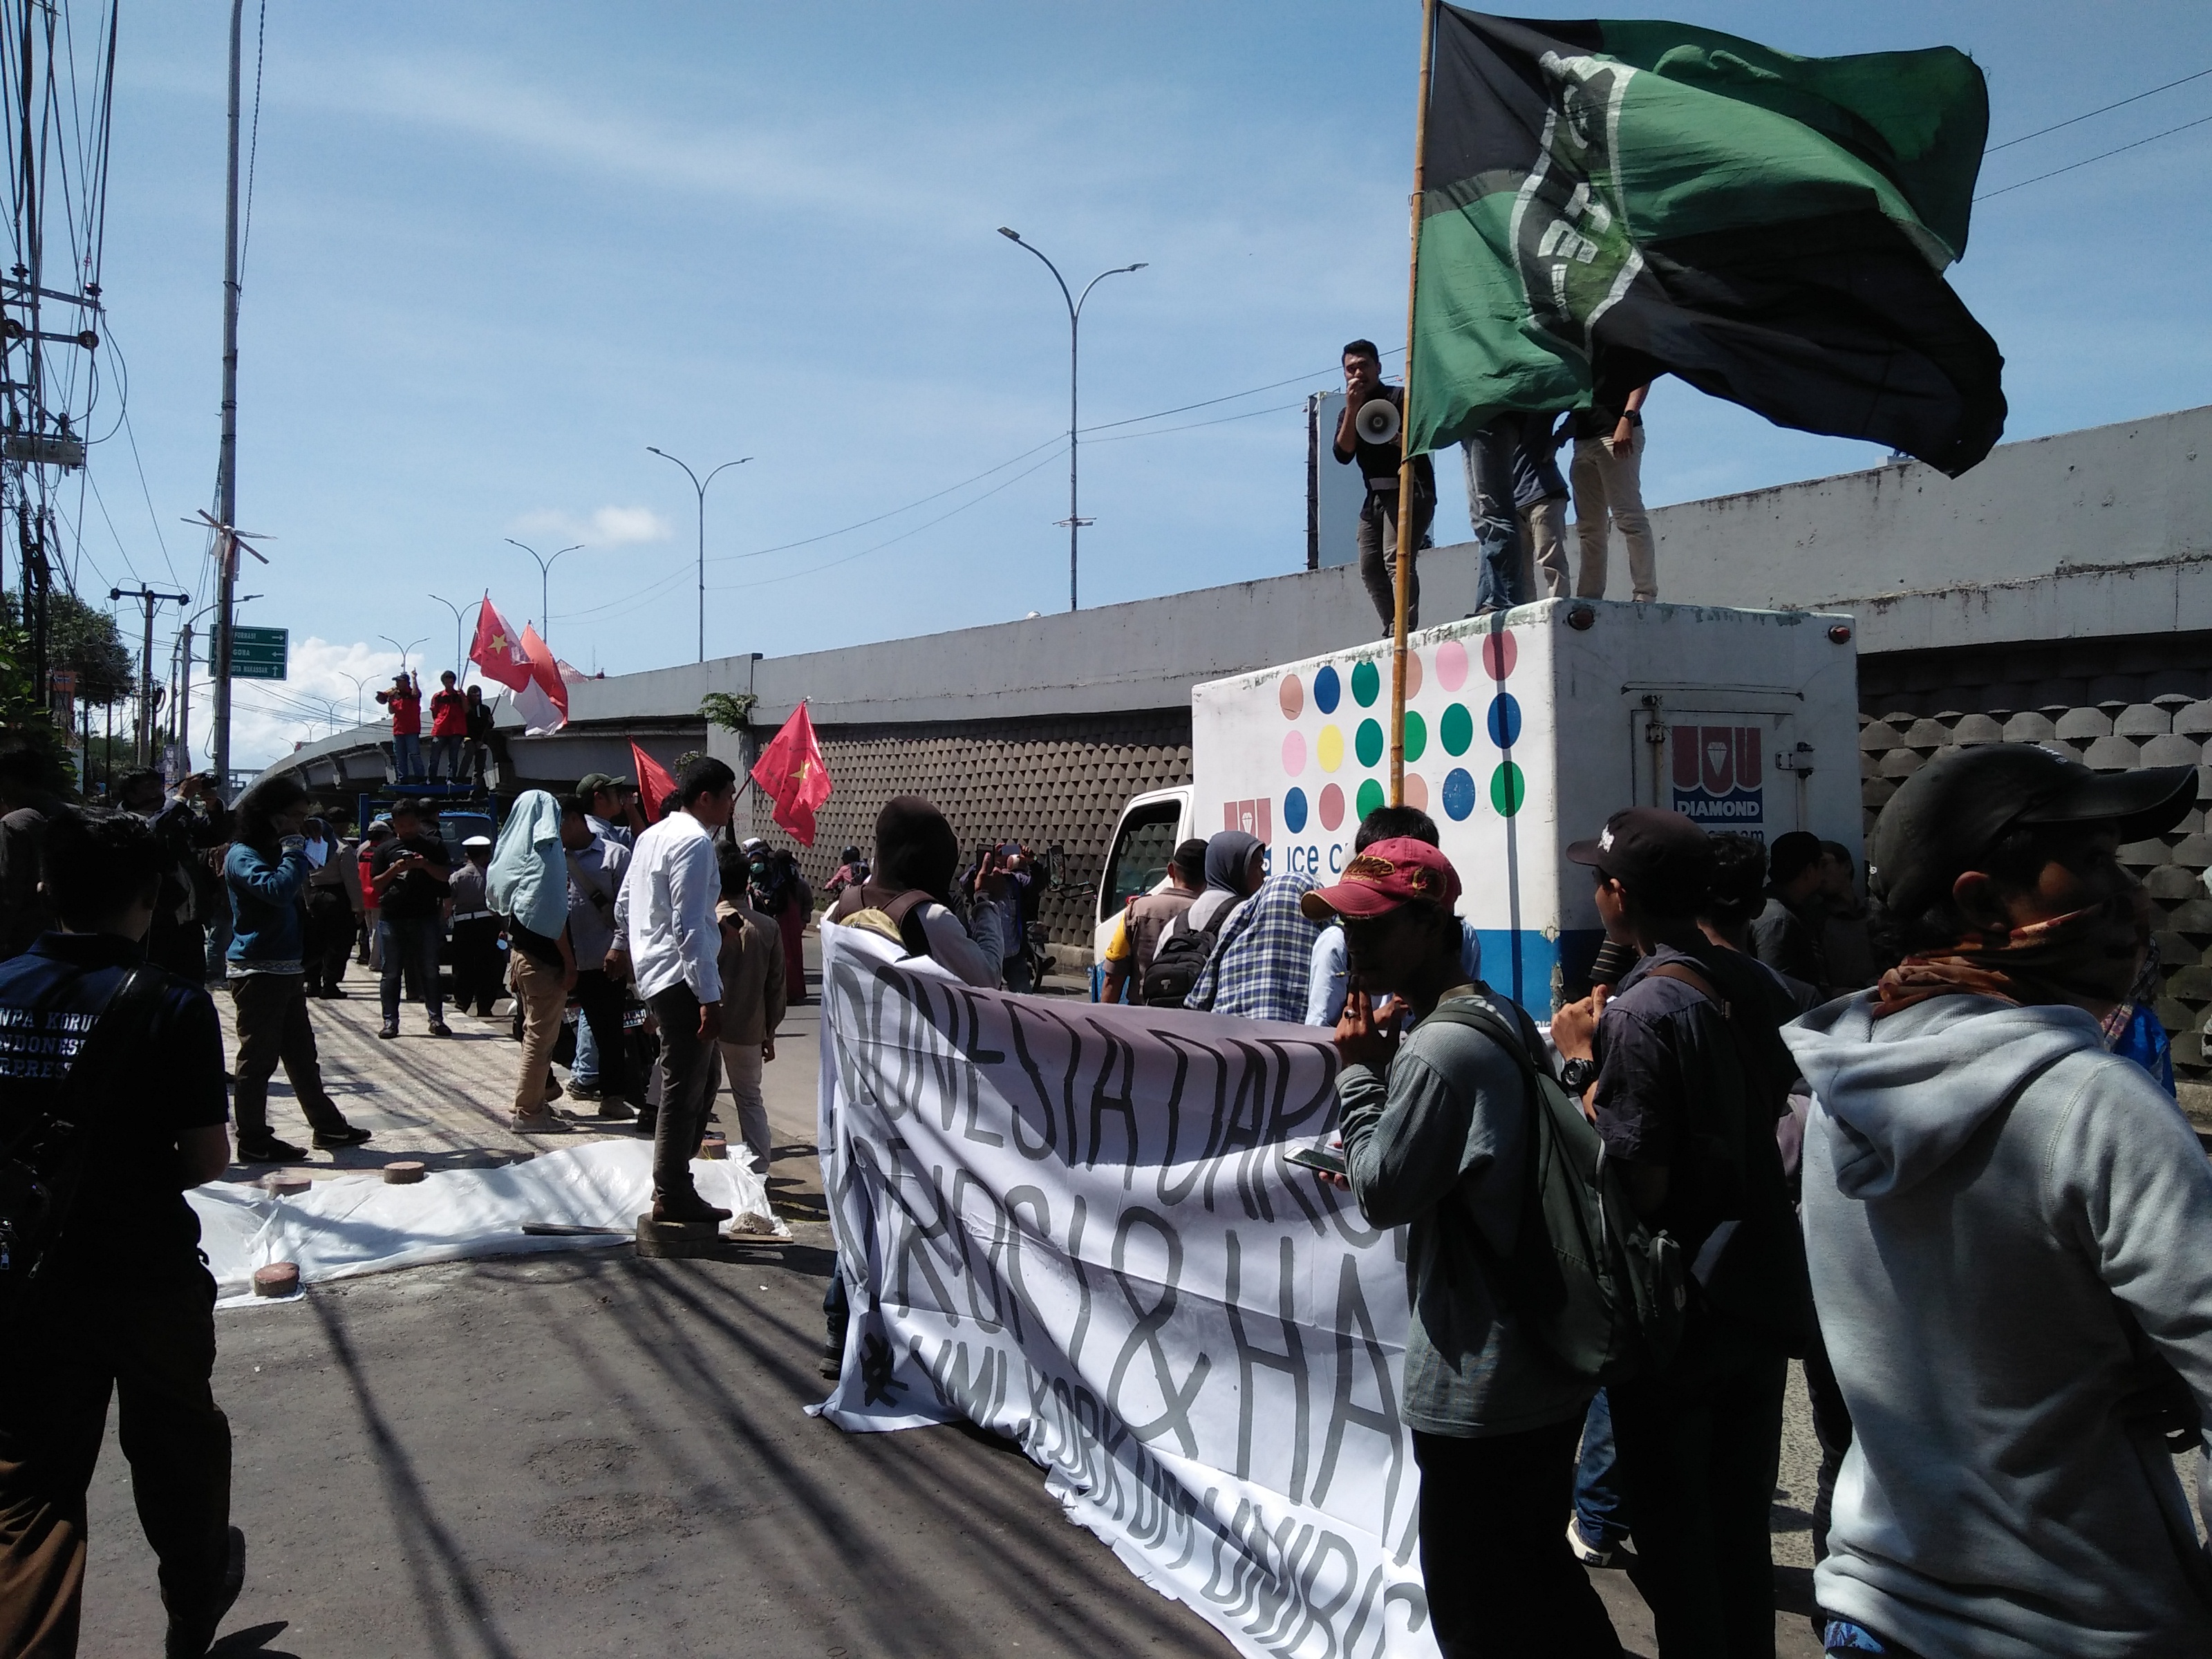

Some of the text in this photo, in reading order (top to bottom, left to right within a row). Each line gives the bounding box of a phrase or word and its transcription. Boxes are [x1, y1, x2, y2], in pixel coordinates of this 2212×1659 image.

[1677, 800, 1760, 817] DIAMOND
[45, 1011, 102, 1033] KORU
[1146, 1029, 1407, 1262] DARU
[1107, 1206, 1211, 1460] &
[1226, 1230, 1420, 1567] HA
